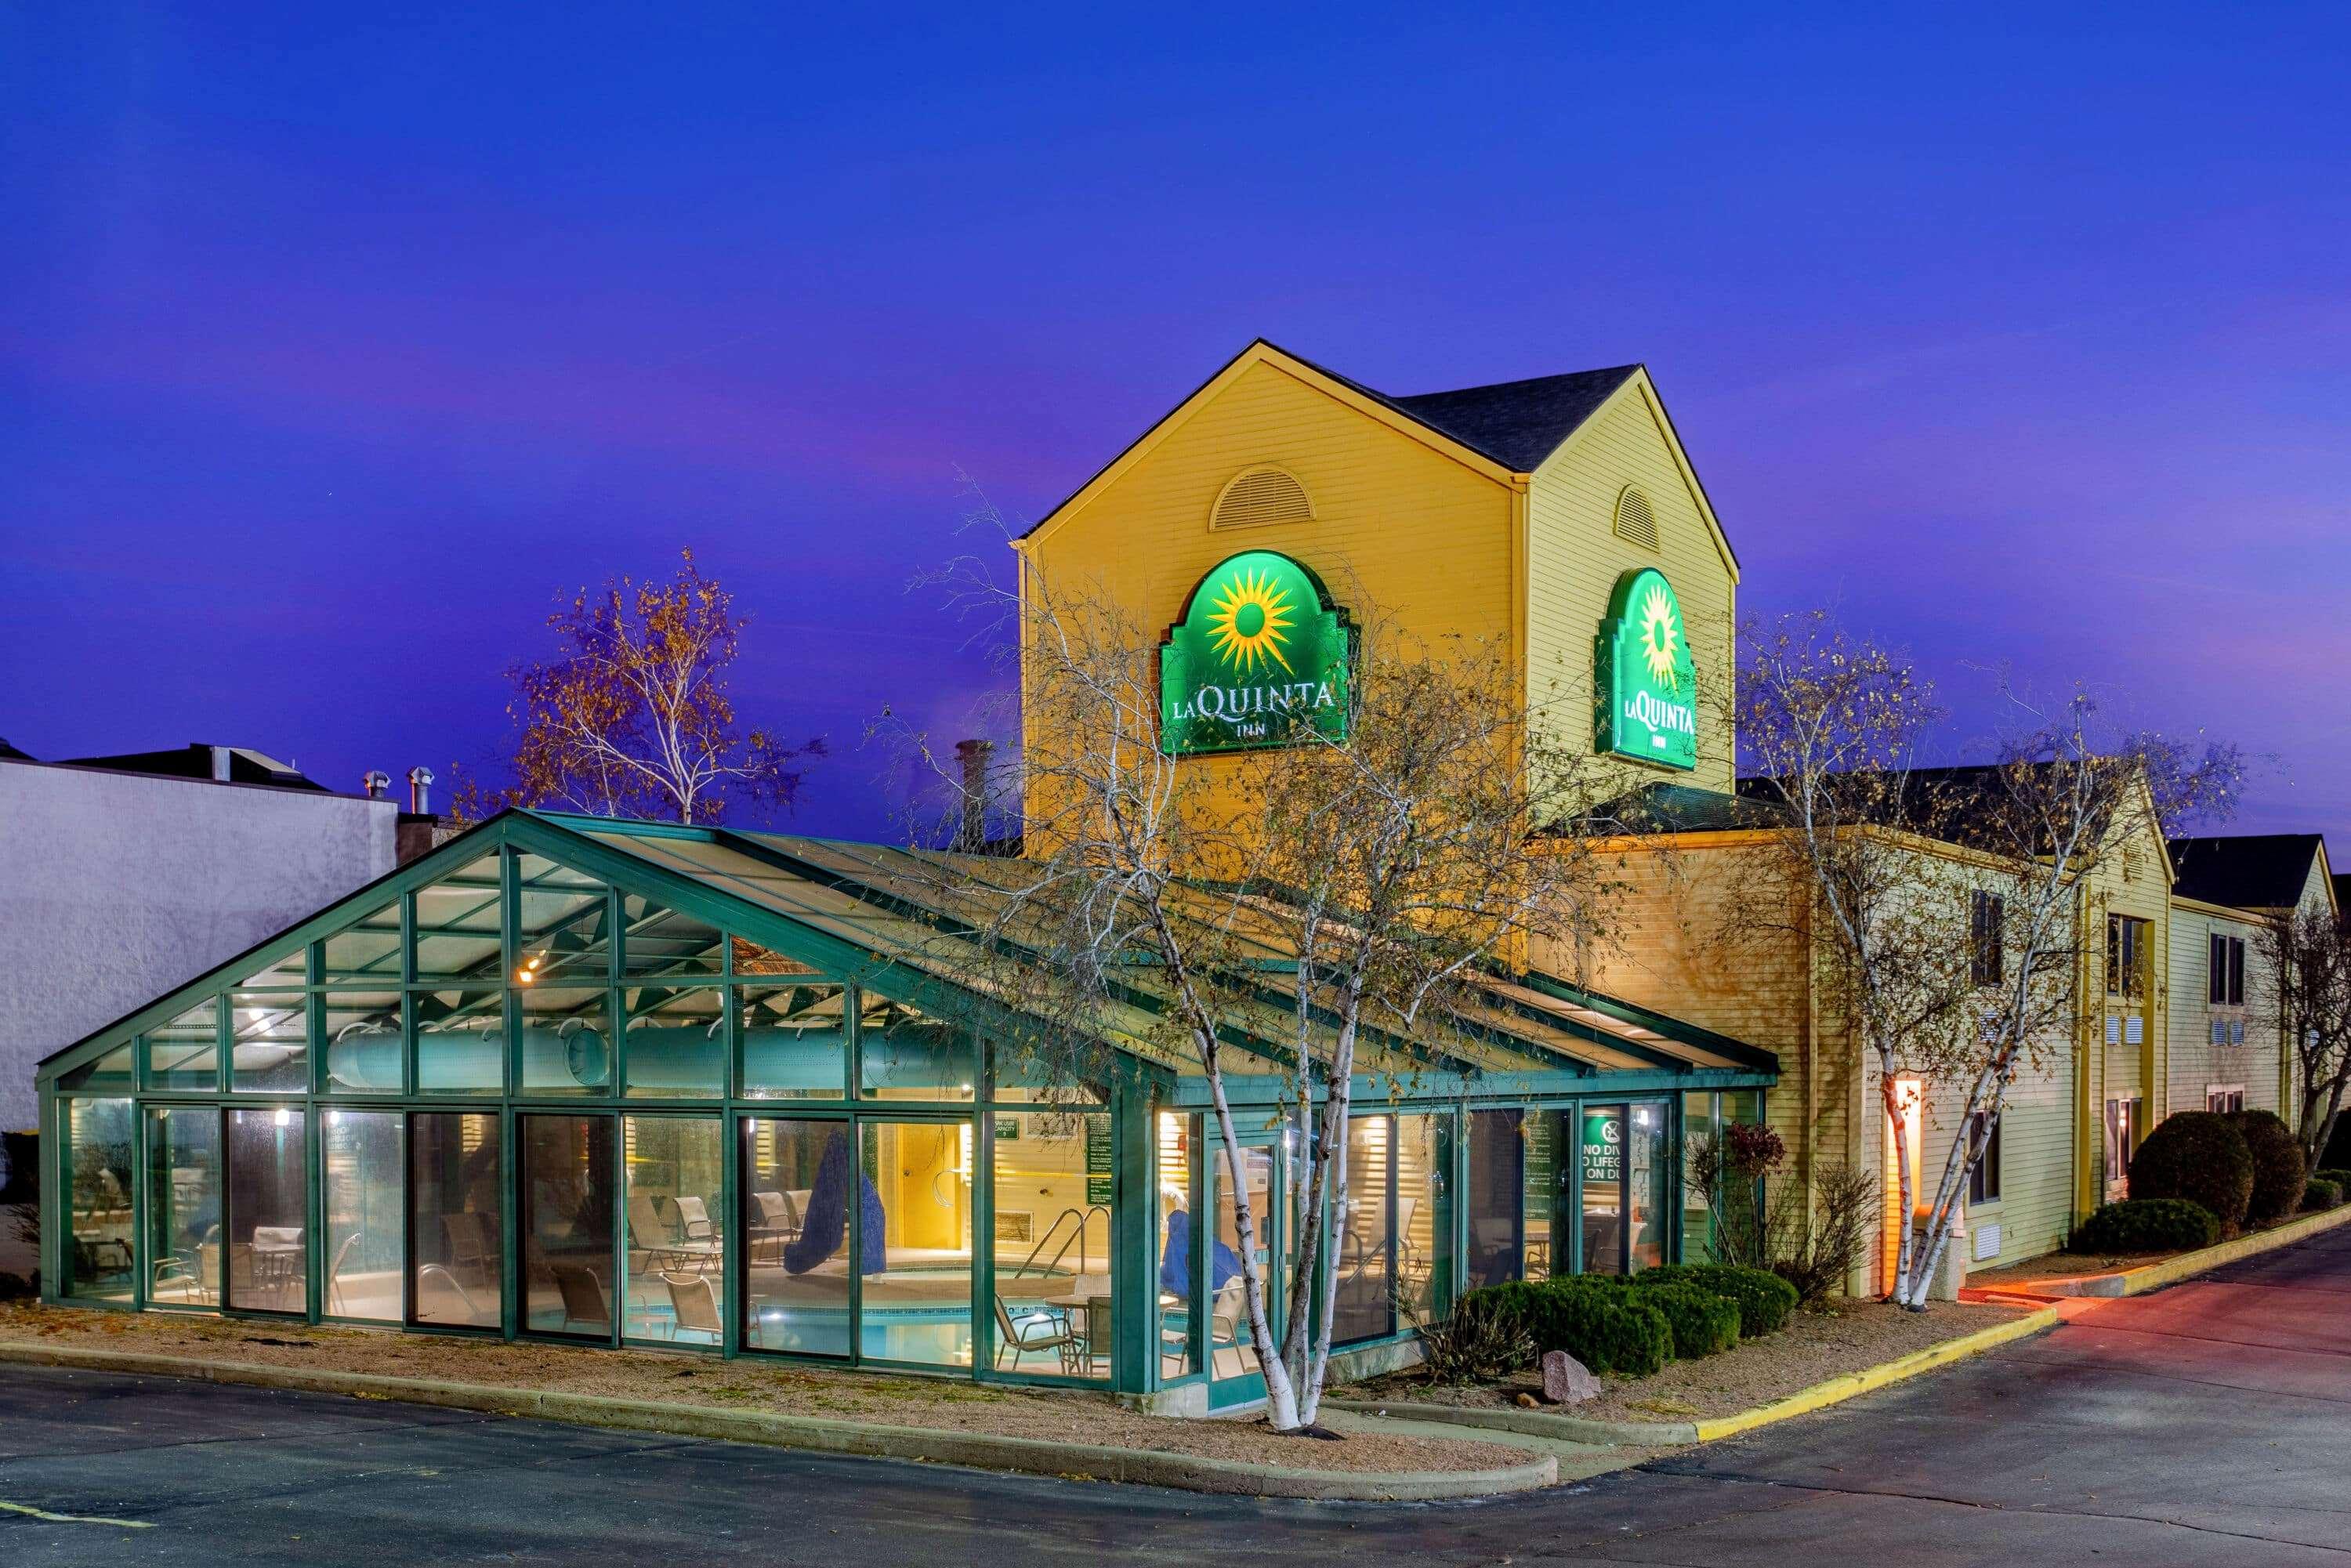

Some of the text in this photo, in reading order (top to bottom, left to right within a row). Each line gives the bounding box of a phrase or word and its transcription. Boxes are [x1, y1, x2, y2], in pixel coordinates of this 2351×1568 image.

[1172, 681, 1334, 722] LA QUINTA
[1625, 690, 1694, 735] LA QUINTA
[1237, 723, 1266, 737] INN
[1583, 1144, 1621, 1155] NO DIV
[1593, 1157, 1621, 1168] LIFEG
[1587, 1168, 1604, 1179] ON
